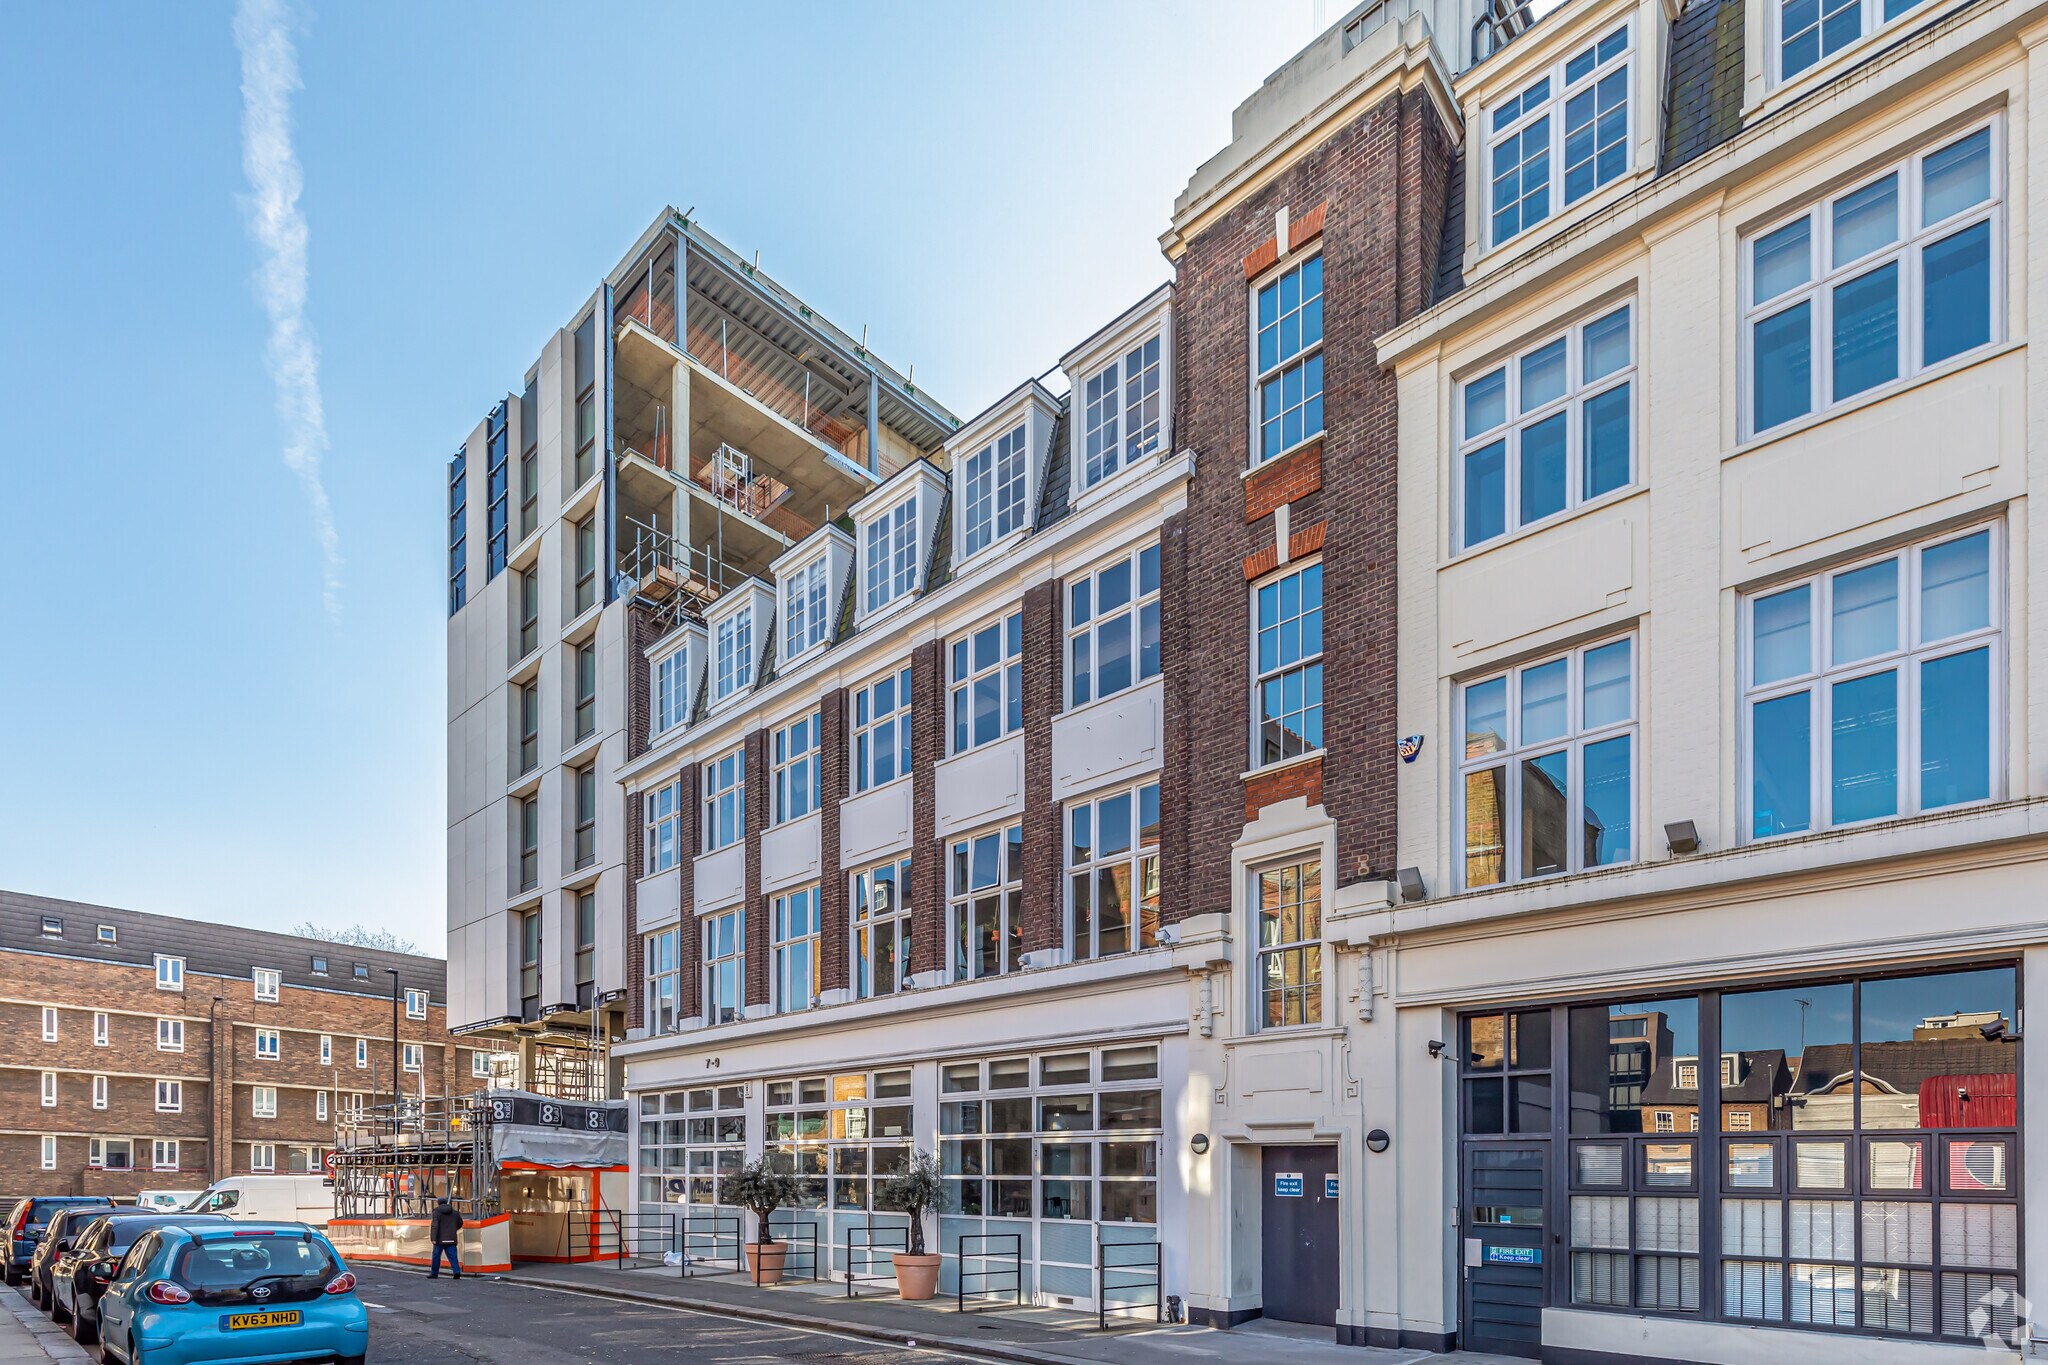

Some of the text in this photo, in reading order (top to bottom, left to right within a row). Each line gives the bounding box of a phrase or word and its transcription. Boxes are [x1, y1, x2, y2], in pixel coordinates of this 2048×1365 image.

[705, 1058, 720, 1069] 7-9
[492, 1100, 504, 1120] 8
[542, 1104, 553, 1123] 8
[589, 1110, 599, 1128] 8
[232, 1312, 297, 1327] KV63 NHD
